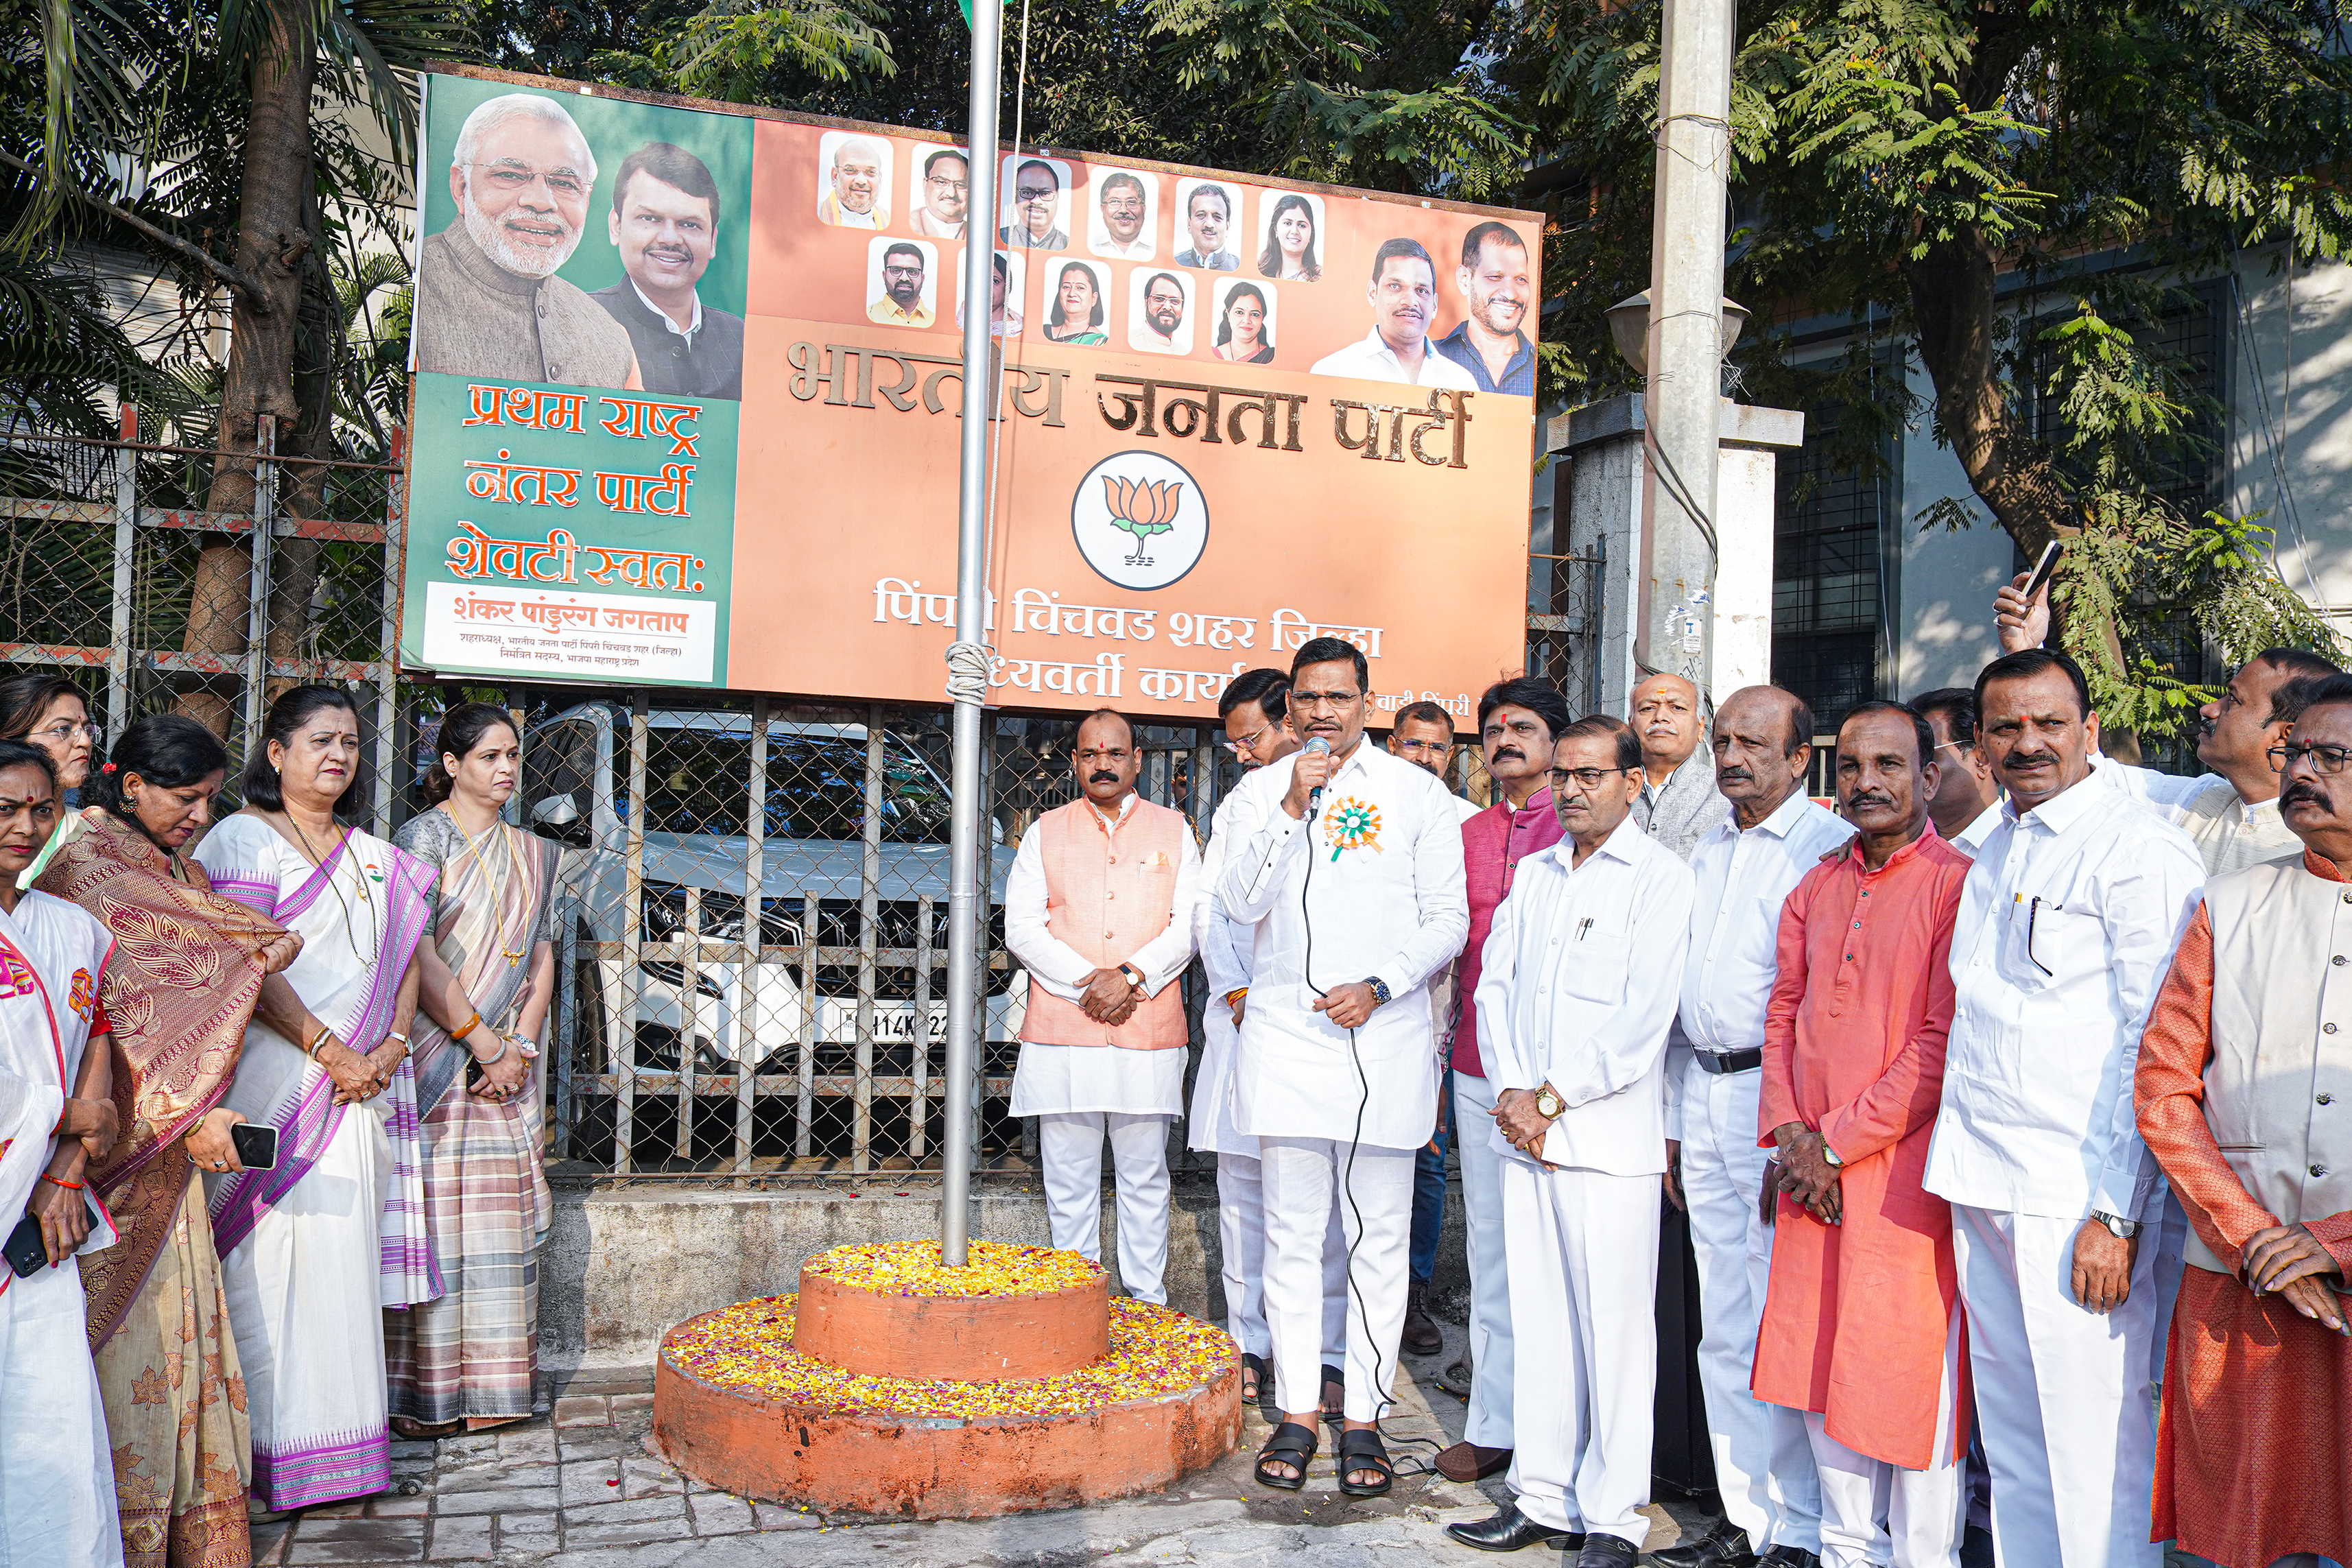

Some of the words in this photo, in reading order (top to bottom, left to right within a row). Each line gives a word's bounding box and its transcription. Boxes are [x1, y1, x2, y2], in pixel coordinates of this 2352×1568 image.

[462, 384, 588, 434] प्रथम
[599, 396, 702, 458] राष्ट्र
[1095, 373, 1307, 451] जनता
[1330, 388, 1474, 469] पार्टी
[464, 448, 582, 508] नंतर
[594, 463, 696, 517] पार्टी
[445, 521, 580, 584] शेवटी
[454, 591, 516, 622] शंकर
[521, 595, 597, 634] पांडुरंग
[603, 608, 689, 633] जगताप
[1011, 588, 1158, 641] चिंचवड
[1168, 612, 1257, 650] शहर
[460, 633, 504, 645] शहराध्यक्ष,
[508, 635, 535, 646] भारतीय
[538, 639, 558, 648] जनता
[562, 639, 578, 649] पार्टी
[580, 639, 599, 650] पिंपरी
[602, 641, 631, 652] चिंचवड
[634, 645, 649, 654] शहर
[652, 644, 682, 657] (जिल्हा)
[500, 646, 531, 659] निमंत्रित
[534, 652, 563, 663] सदस्य,
[567, 654, 591, 663] भाजपा
[595, 656, 620, 667] महाराष्ट्र
[621, 656, 639, 667] प्रदेश
[948, 652, 1126, 698] ध्यवर्ती
